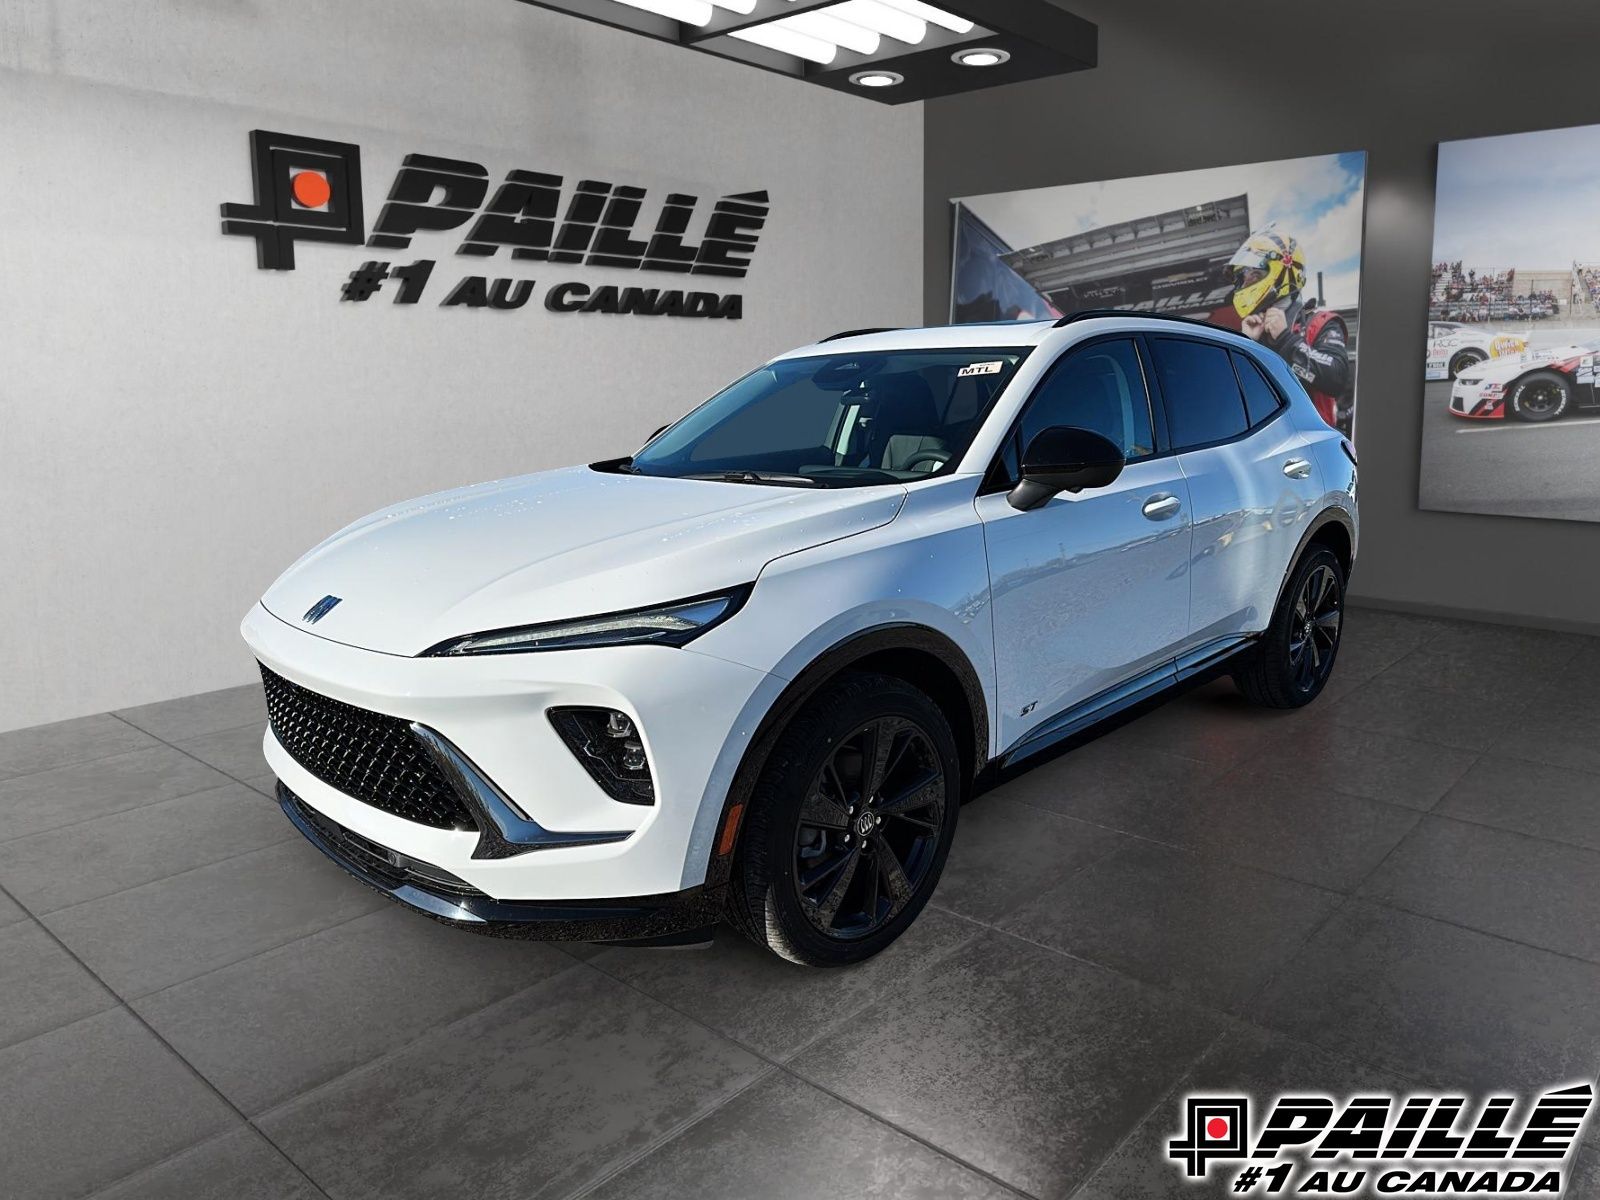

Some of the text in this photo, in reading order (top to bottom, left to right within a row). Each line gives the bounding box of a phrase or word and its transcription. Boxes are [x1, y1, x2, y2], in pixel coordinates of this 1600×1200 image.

[366, 153, 770, 278] PAILLÉ
[340, 259, 743, 320] #1 AU CANADA
[961, 366, 993, 375] MTL
[1020, 700, 1038, 717] ST
